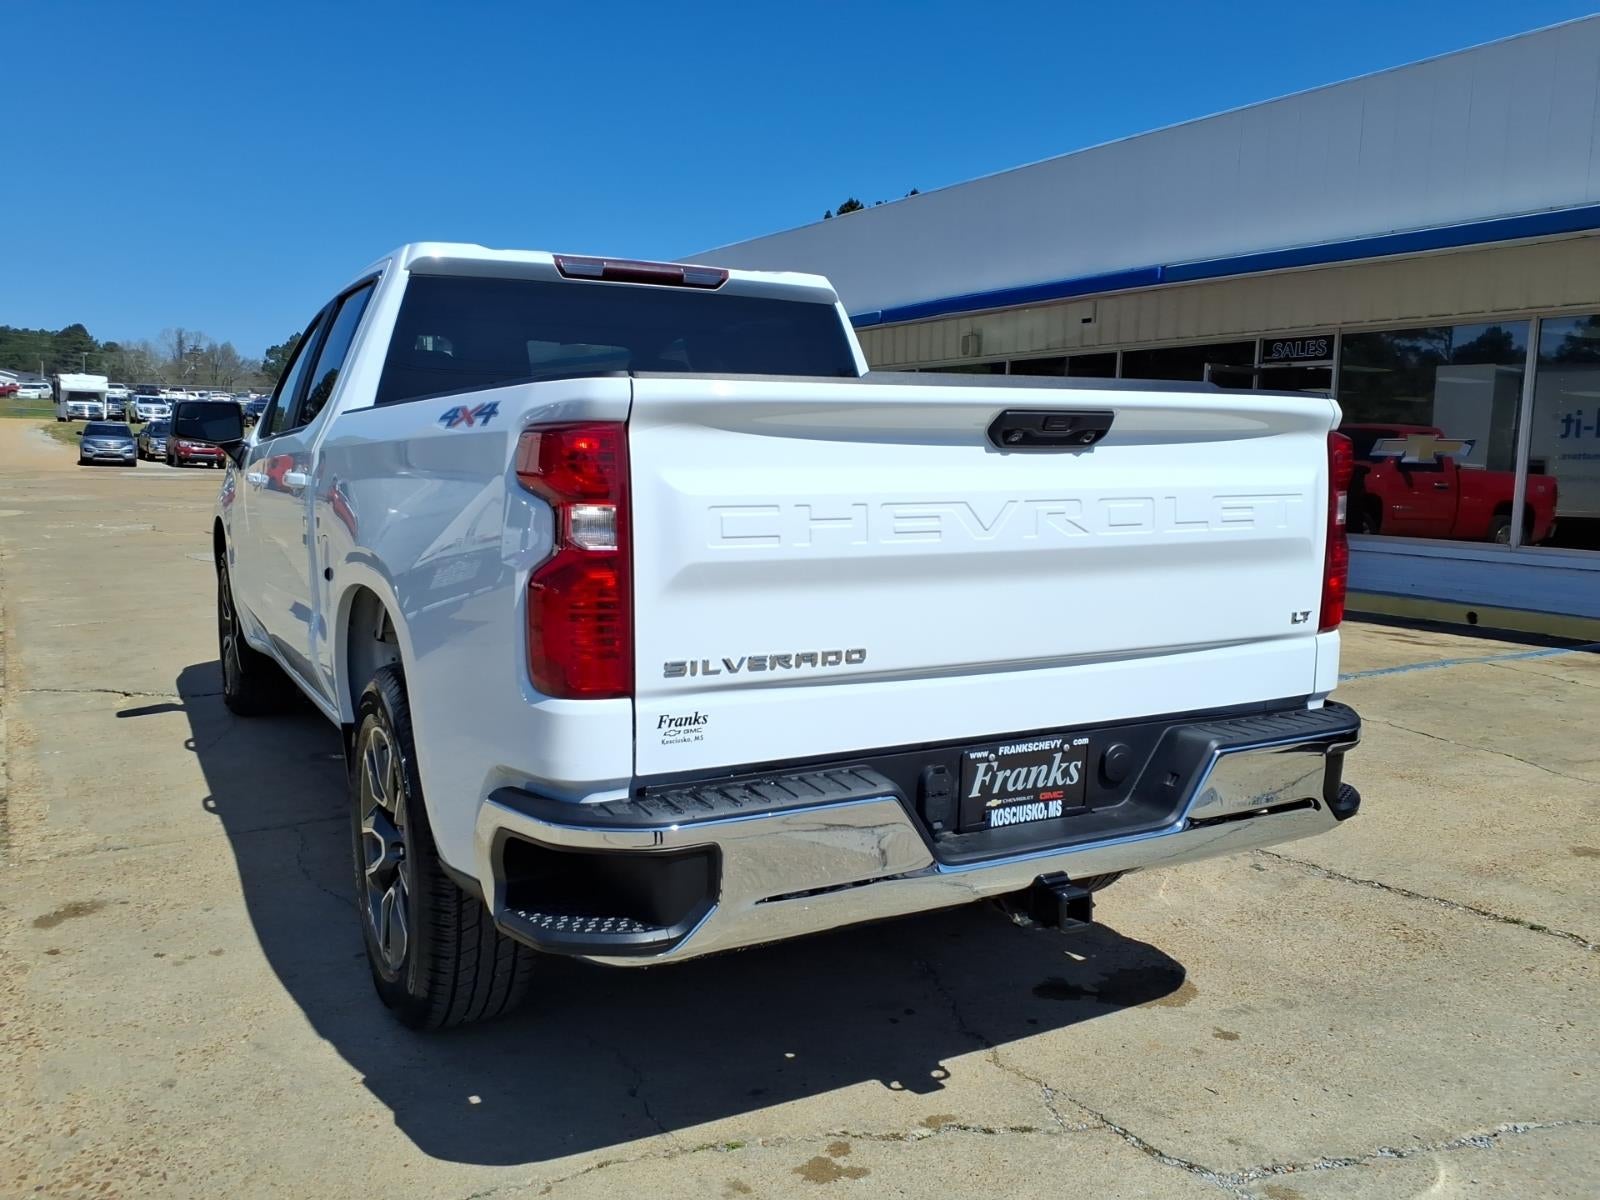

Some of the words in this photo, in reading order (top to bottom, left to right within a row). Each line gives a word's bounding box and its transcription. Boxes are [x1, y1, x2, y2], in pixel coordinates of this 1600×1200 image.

[1271, 339, 1328, 359] SALES
[706, 493, 1304, 549] CHEVROLET
[1291, 610, 1312, 625] LT
[663, 648, 867, 678] SILVERADO
[656, 711, 709, 729] Franks
[998, 739, 1063, 756] FRANKSCHEVY
[968, 752, 1082, 798] Franks
[1002, 794, 1034, 804] CHEVROLET
[1039, 790, 1064, 800] GMC
[991, 802, 1047, 827] KOSCIUSKO,
[1048, 799, 1063, 818] MS
